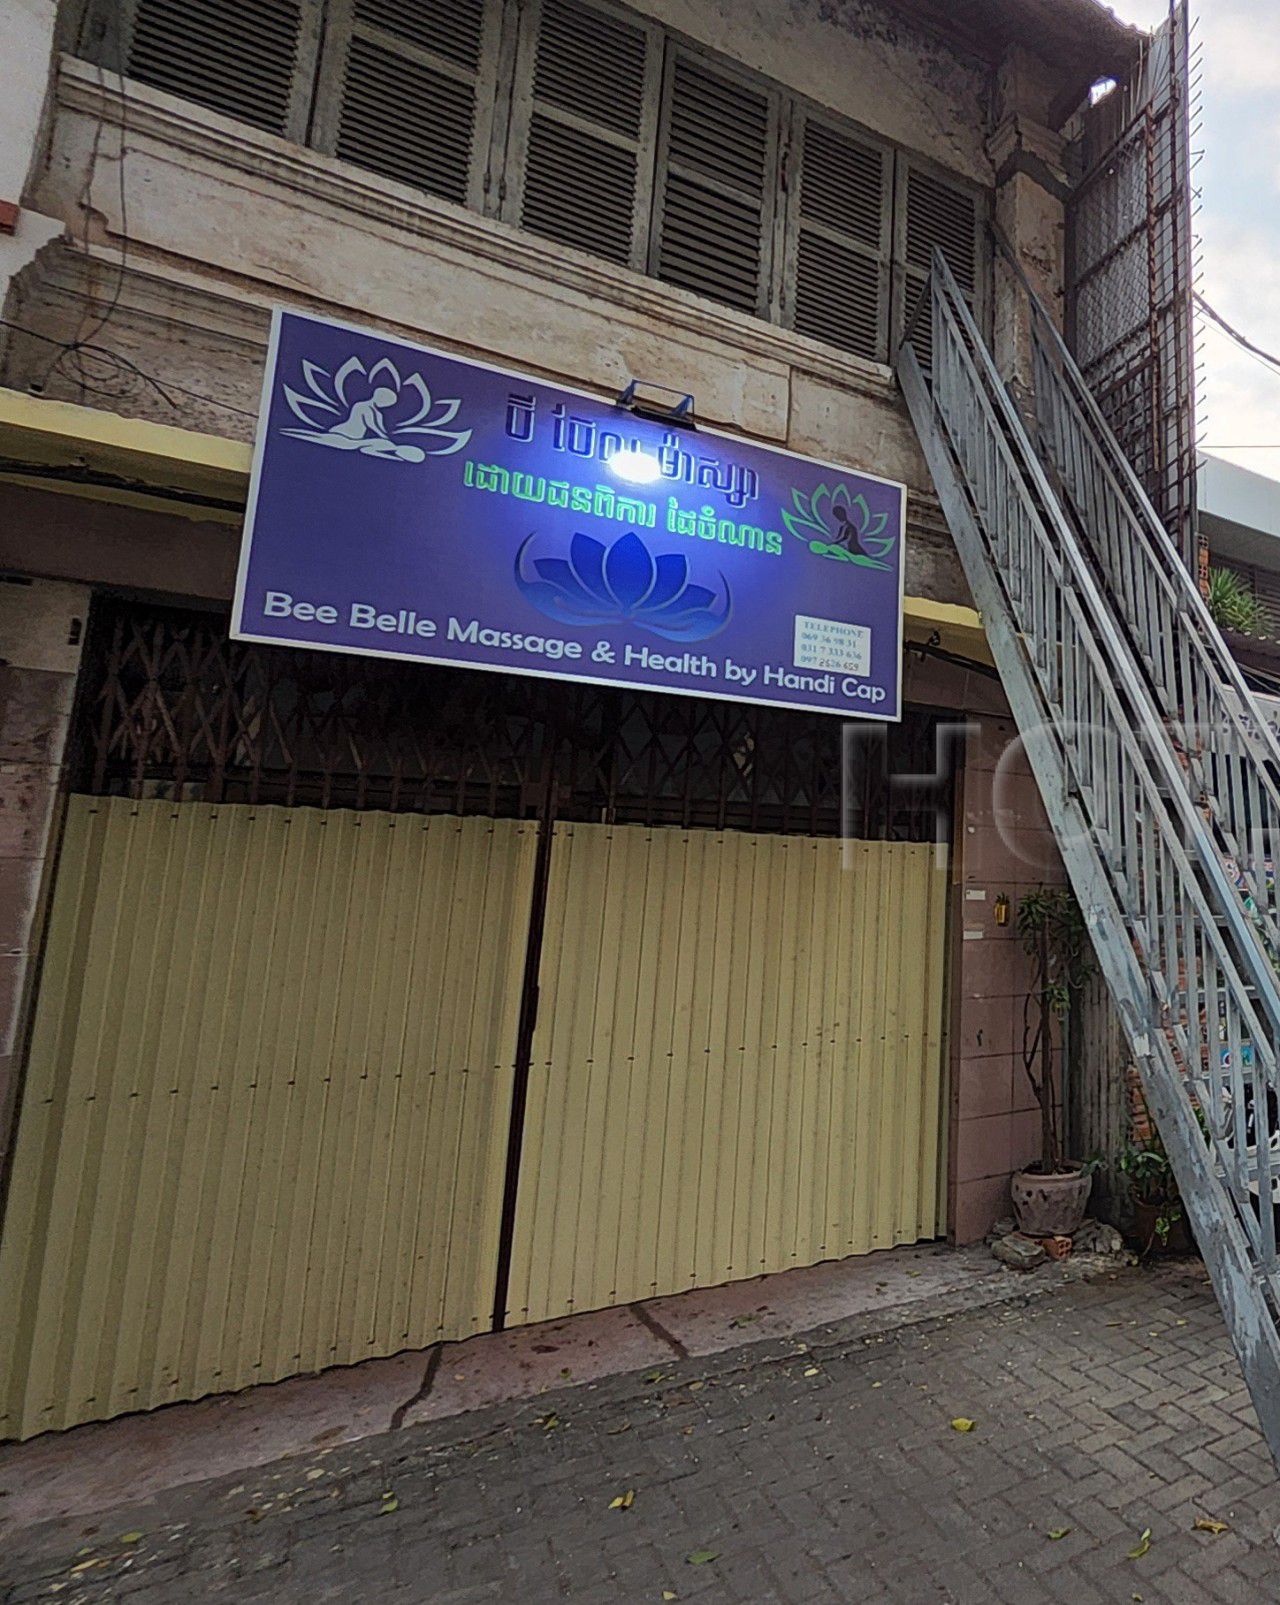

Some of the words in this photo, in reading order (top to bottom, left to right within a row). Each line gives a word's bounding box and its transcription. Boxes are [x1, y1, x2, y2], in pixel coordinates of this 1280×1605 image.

[263, 591, 339, 624] Bee
[349, 602, 437, 638] Belle
[447, 617, 583, 660] Massage
[591, 641, 616, 664] &
[624, 644, 717, 678] Health
[724, 657, 757, 686] by
[764, 665, 836, 695] Handi
[841, 676, 886, 704] Cap
[804, 621, 864, 639] TELEPHONE
